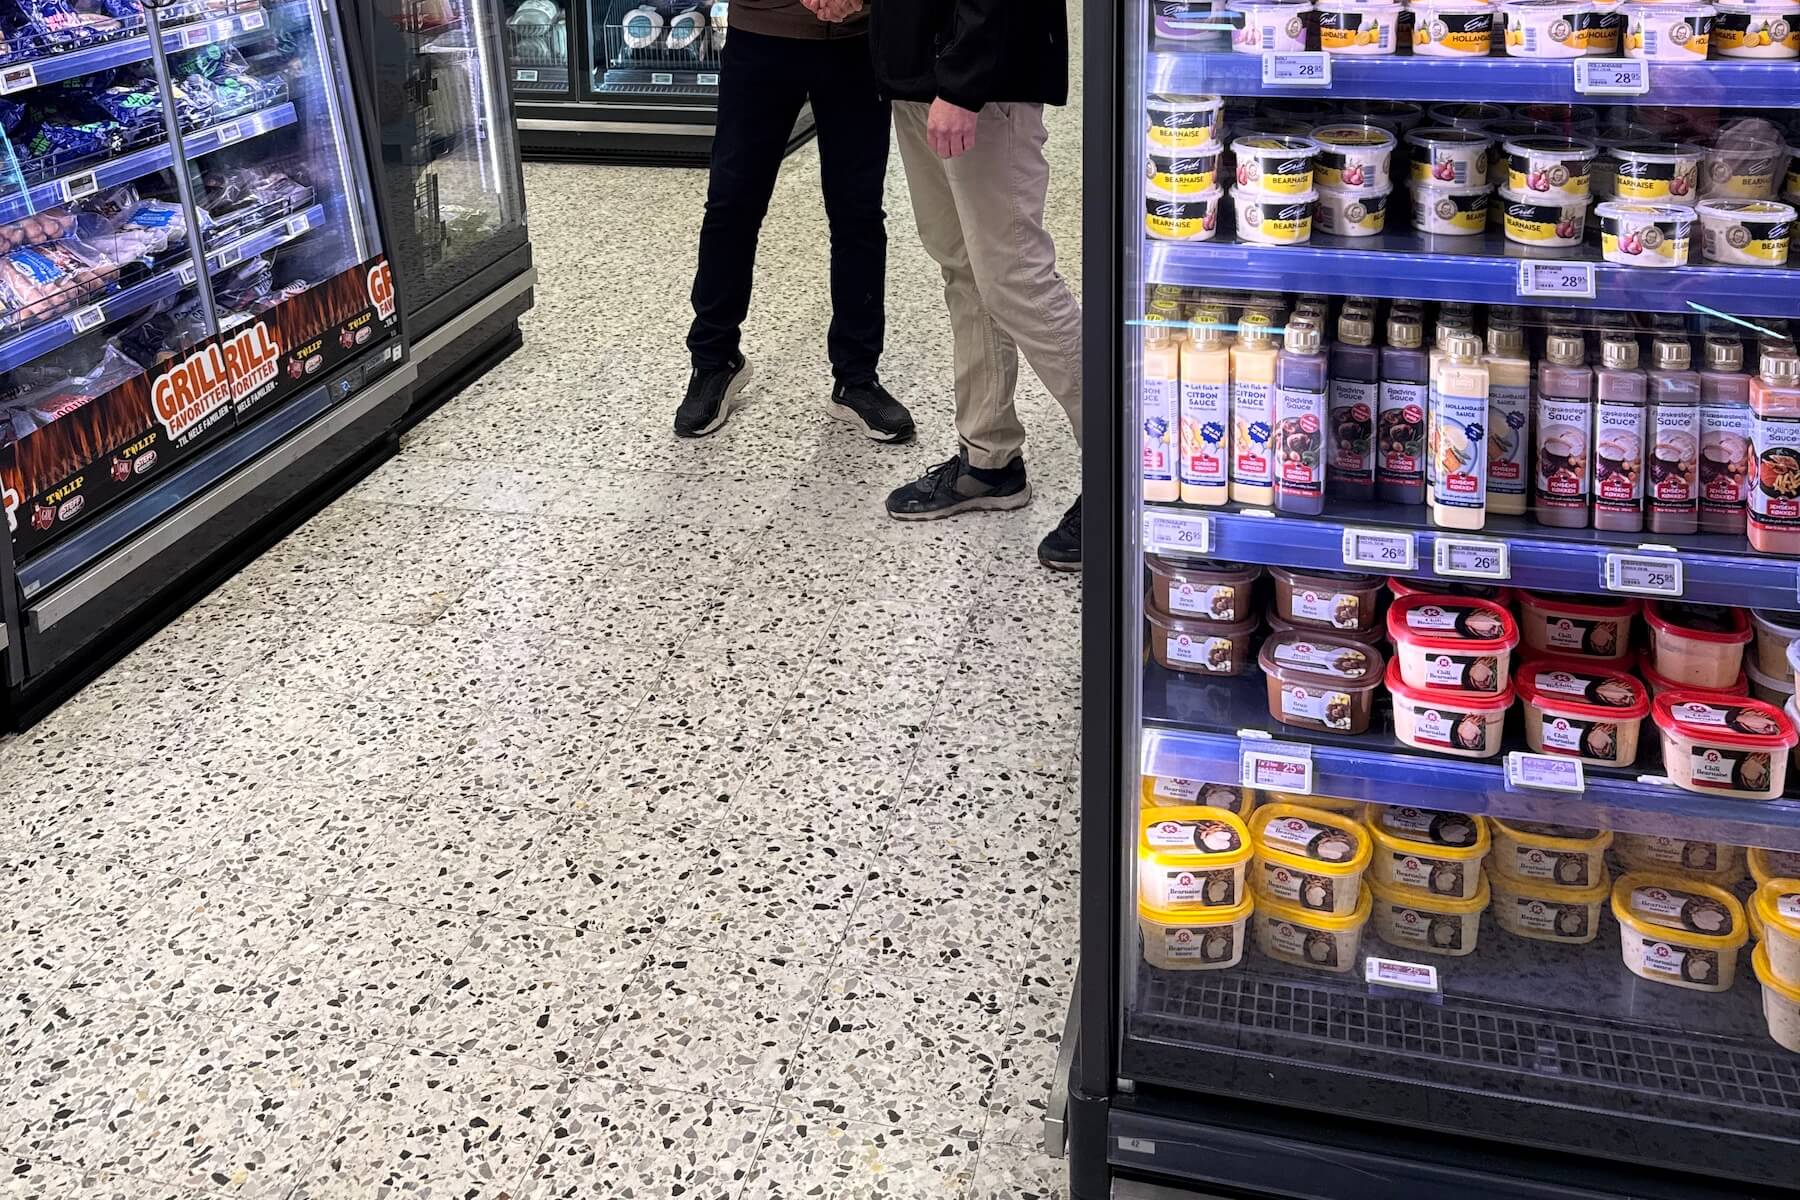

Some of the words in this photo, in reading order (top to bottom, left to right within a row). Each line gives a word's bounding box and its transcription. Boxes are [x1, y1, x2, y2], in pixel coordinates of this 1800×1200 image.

[1164, 175, 1204, 184] BEARNAISE
[1272, 175, 1309, 184] BEARNAISE
[1152, 219, 1191, 229] BEARNAISE
[1561, 276, 1577, 287] 28
[156, 347, 226, 421] GRILL
[1236, 391, 1266, 399] CITRON
[1189, 399, 1216, 407] SAUCE
[169, 384, 229, 434] FAVORITTER
[1548, 412, 1581, 421] Sauce
[1602, 416, 1635, 426] Sauce
[188, 425, 203, 441] HELE
[203, 407, 229, 430] FAMILIEN
[1657, 417, 1691, 427] Sauce
[1707, 418, 1741, 428] Sauce
[1769, 434, 1797, 442] Sauce
[123, 432, 157, 458] TULIP
[46, 476, 84, 505] TULIP
[1178, 531, 1193, 542] 26
[1382, 547, 1397, 559] 26
[1474, 557, 1490, 568] 26
[1648, 573, 1664, 585] 25
